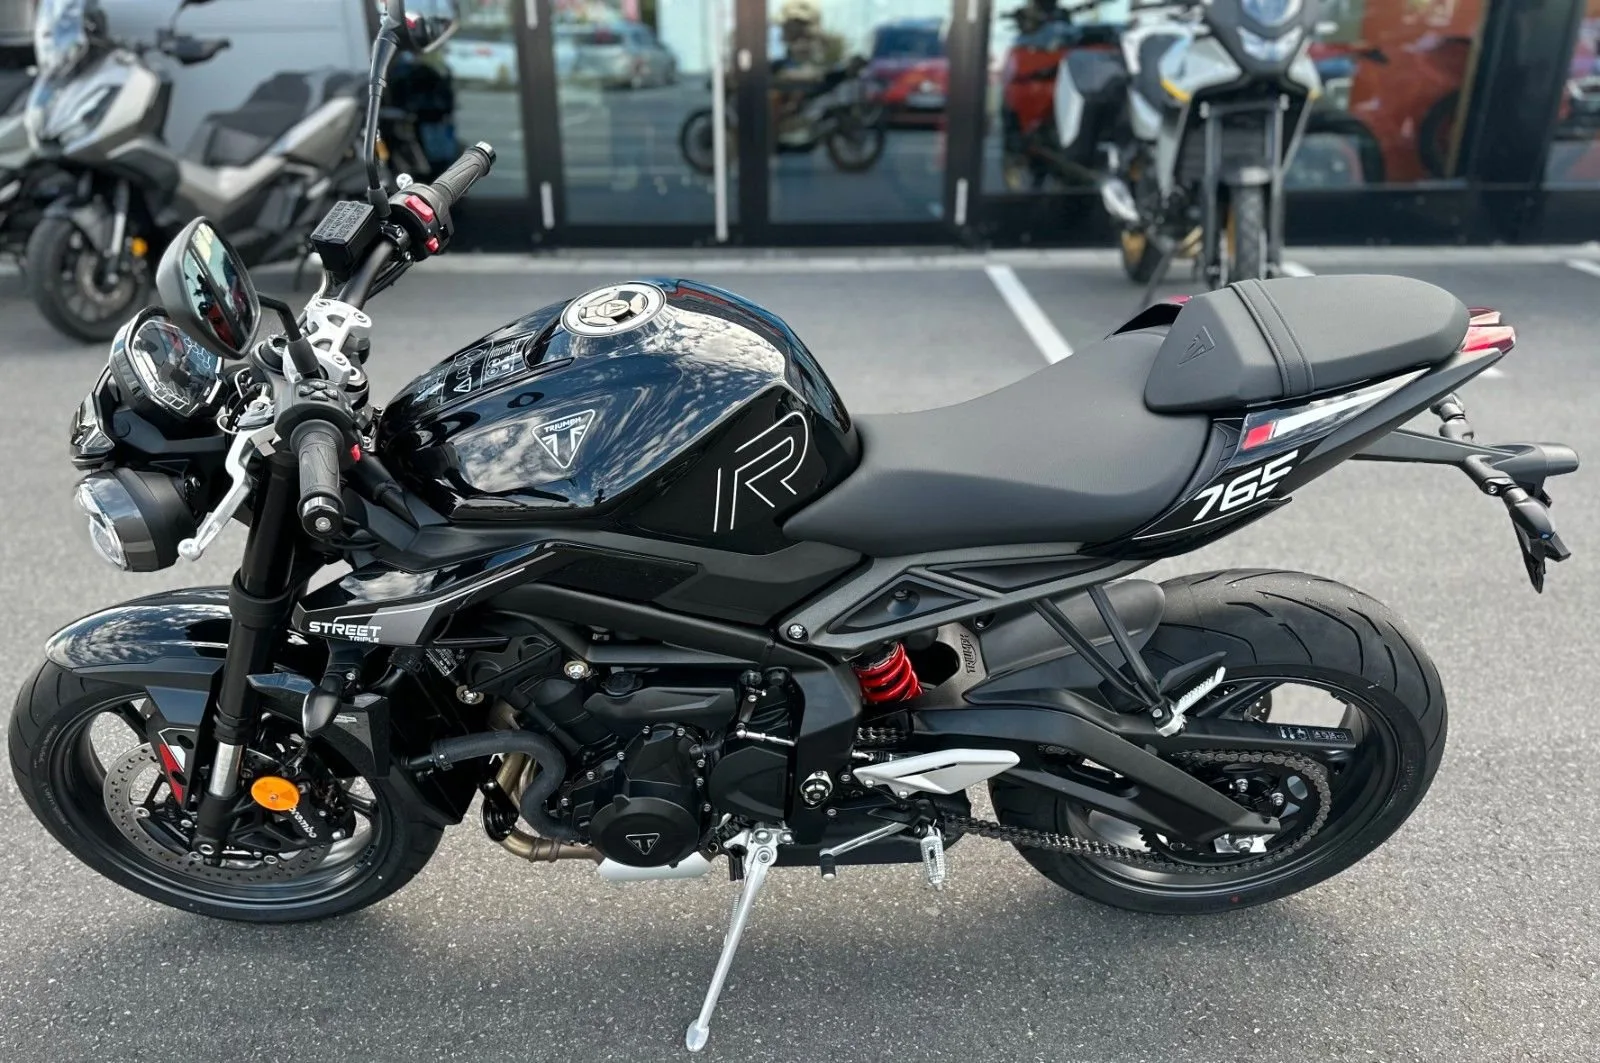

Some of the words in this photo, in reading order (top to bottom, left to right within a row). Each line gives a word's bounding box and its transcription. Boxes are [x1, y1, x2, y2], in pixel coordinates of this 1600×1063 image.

[543, 416, 582, 433] TRIUMPH
[1193, 449, 1299, 522] 765
[308, 621, 382, 637] STREET
[348, 635, 380, 643] TRIPLE
[960, 633, 977, 674] TRIUMPH
